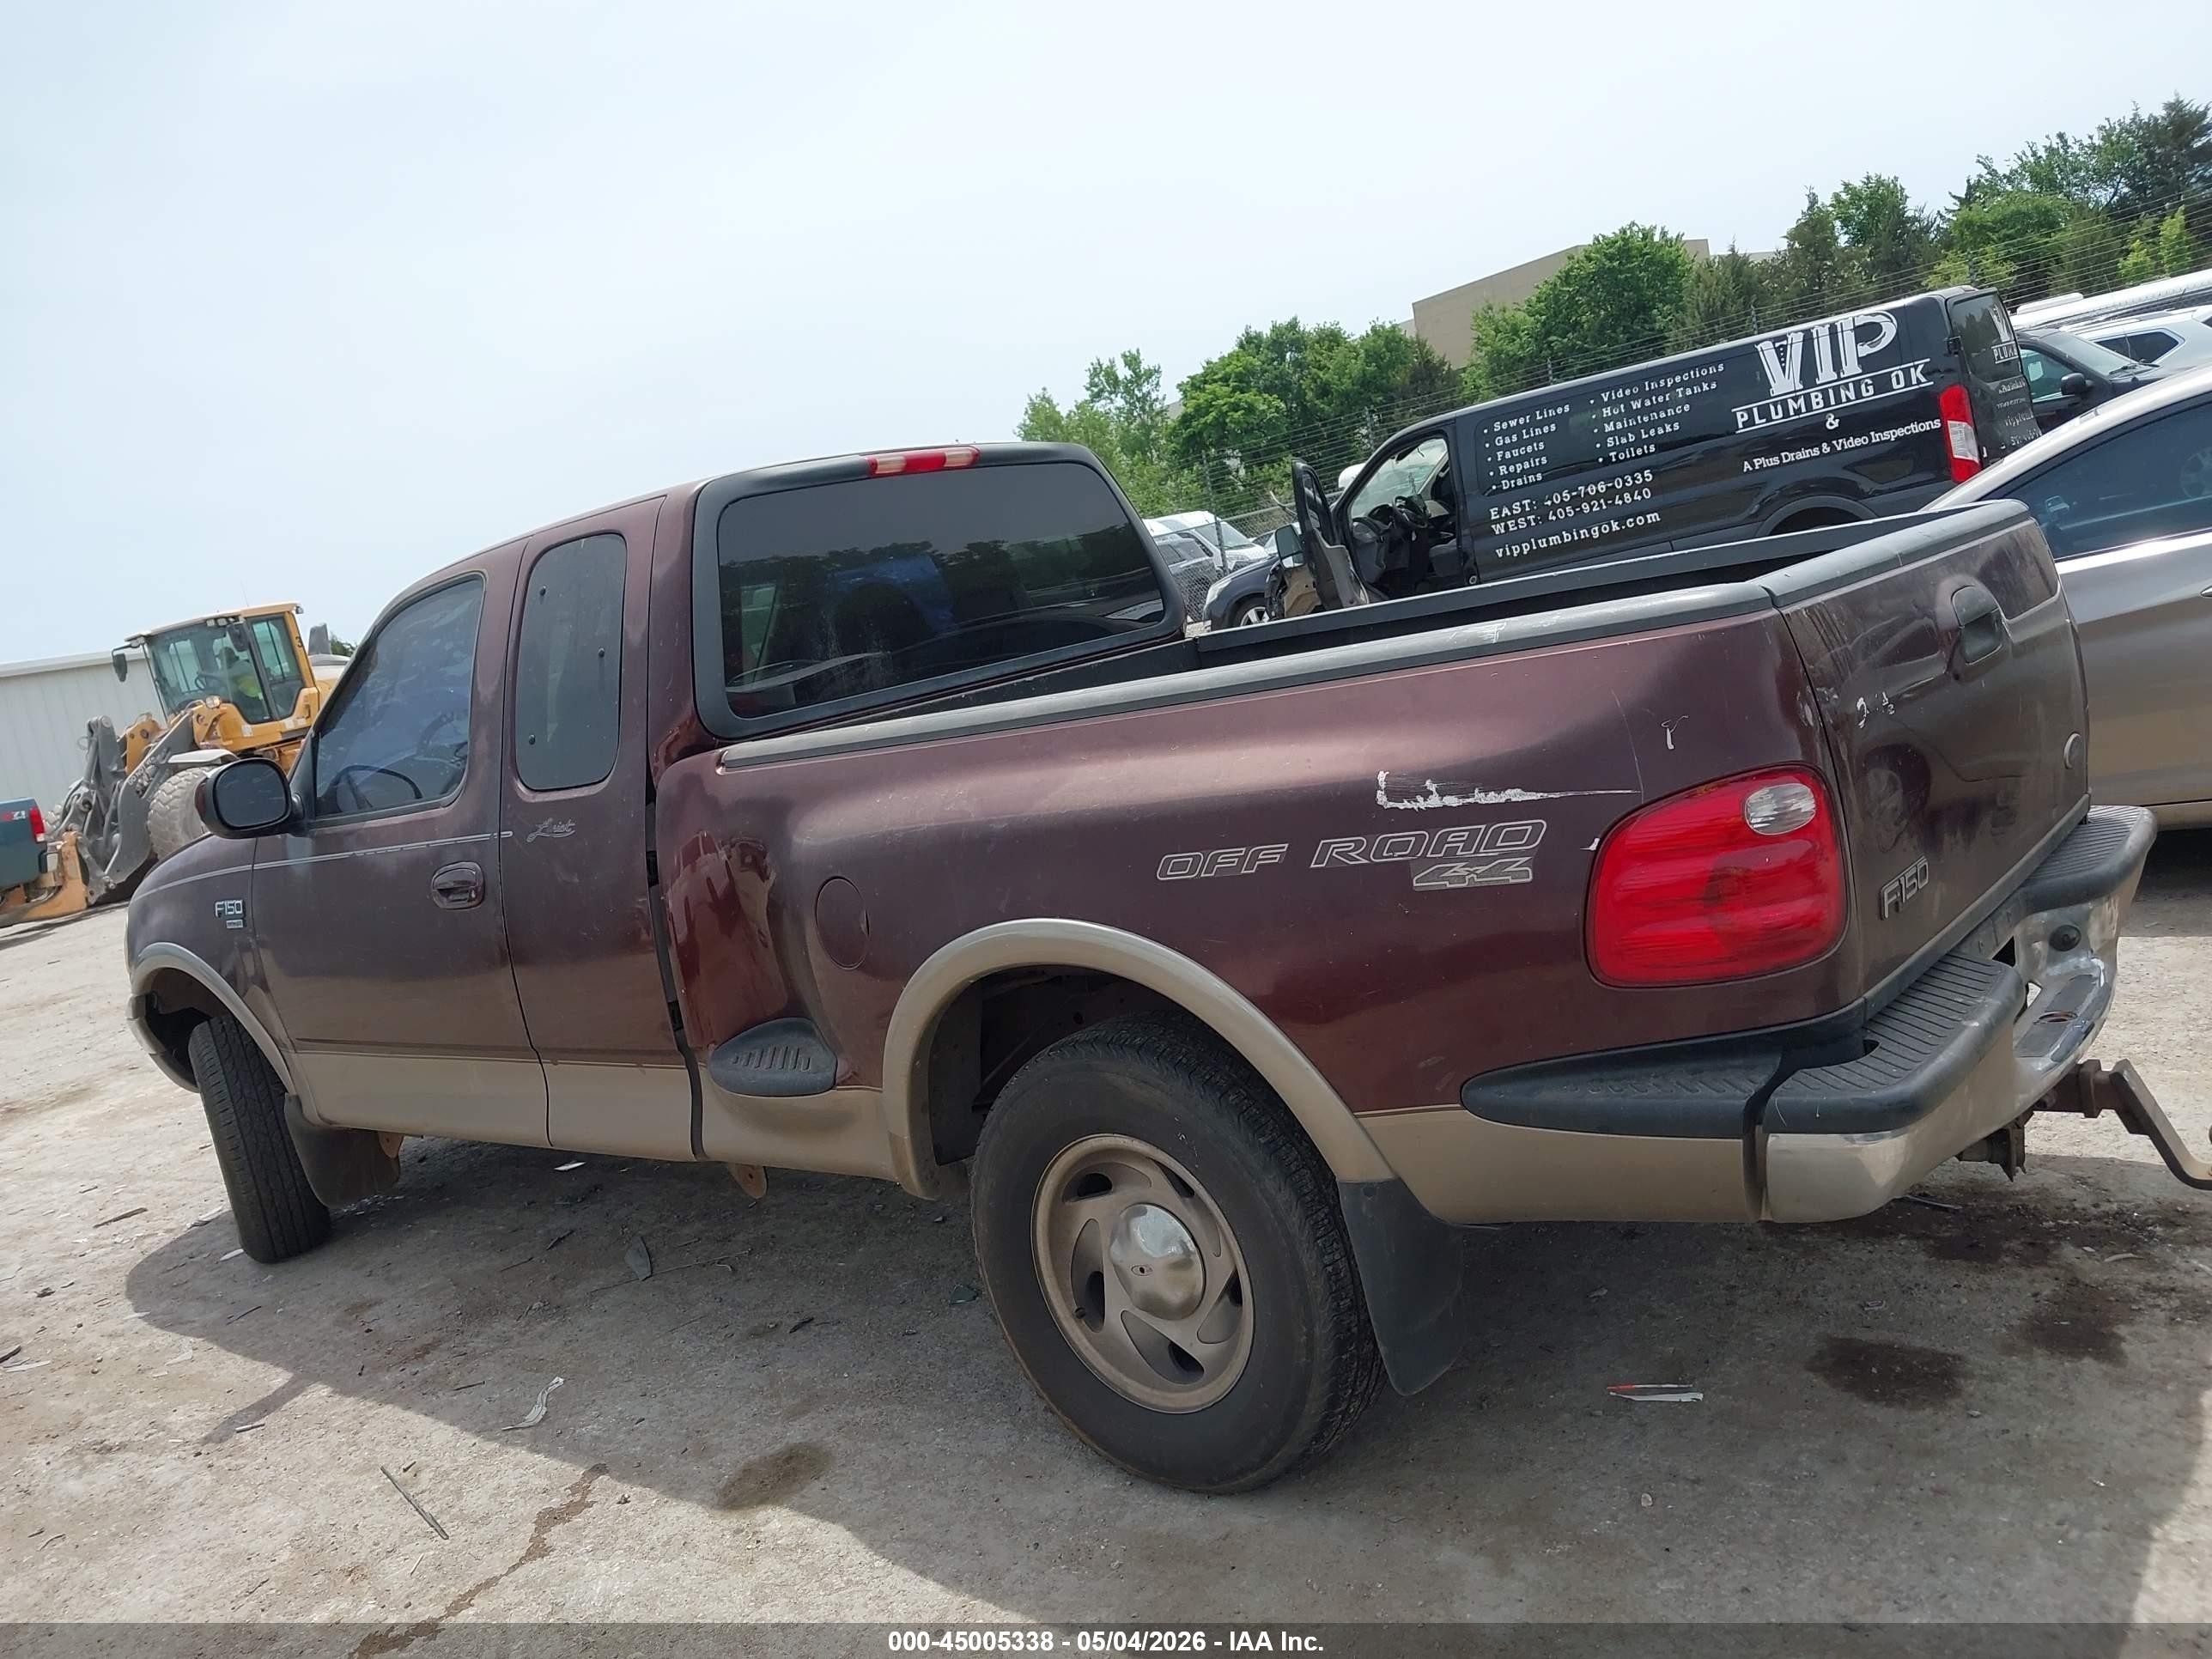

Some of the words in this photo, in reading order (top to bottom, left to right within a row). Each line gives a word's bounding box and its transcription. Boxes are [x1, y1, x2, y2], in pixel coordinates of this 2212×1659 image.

[1754, 310, 1898, 398] VIP
[1601, 386, 1639, 402] Video
[1644, 363, 1724, 392] Inspections
[1735, 379, 1875, 429] PLUMBING
[1891, 363, 1929, 390] OK
[1601, 404, 1625, 417] Hot
[1630, 392, 1671, 410] Water
[1675, 381, 1717, 398] Tanks
[1493, 415, 1530, 432] Sewer
[1535, 404, 1570, 420] Lines
[1603, 404, 1691, 433] Maintenance
[1826, 413, 1839, 429] &
[1495, 434, 1517, 446] Gas
[1522, 423, 1556, 439] Lines
[1607, 432, 1636, 447] Slab
[1641, 422, 1680, 439] Leaks
[1742, 460, 1753, 472] A
[1753, 455, 1780, 470] Plus
[1781, 447, 1820, 463] Drains
[1821, 442, 1831, 453] &
[1832, 432, 1869, 451] Video
[1871, 417, 1941, 442] Inspections
[1496, 441, 1545, 461] Faucets
[1498, 456, 1547, 476] Repairs
[1609, 443, 1656, 463] Toilets
[1489, 499, 1537, 520] EAST:
[1544, 470, 1653, 506] 405-706-0335
[1501, 472, 1542, 489] Drains
[1491, 515, 1543, 536] WEST:
[1548, 488, 1651, 521] 405-921-4840
[1495, 511, 1661, 558] vipplumbingok.com
[1157, 843, 1289, 880] OFF
[1310, 819, 1547, 868] ROAD
[1881, 855, 1929, 920] F150
[215, 899, 243, 917] F150
